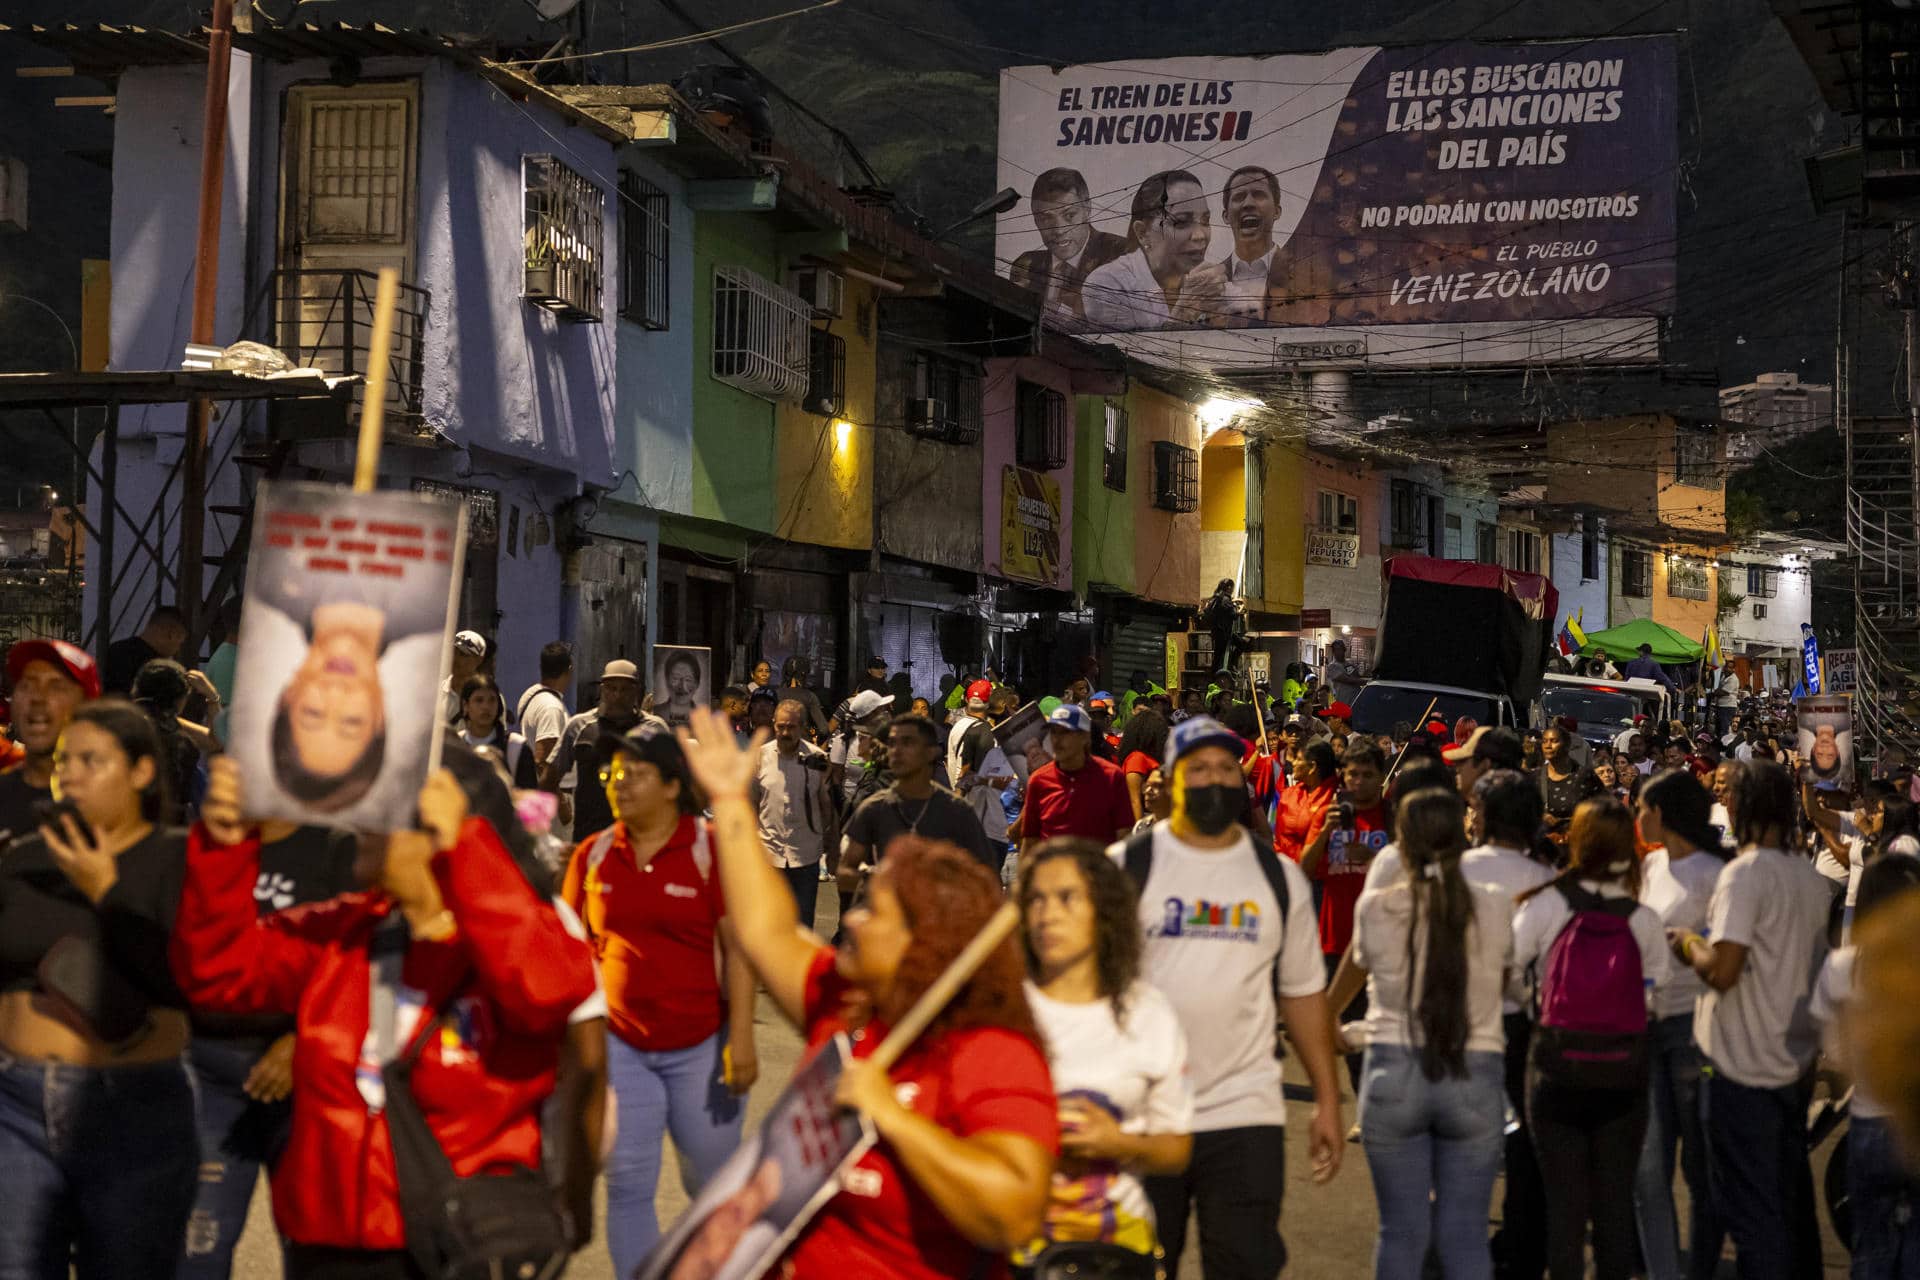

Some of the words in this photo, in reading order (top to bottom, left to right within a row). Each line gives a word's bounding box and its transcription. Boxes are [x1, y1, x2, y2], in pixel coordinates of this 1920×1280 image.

[1058, 87, 1083, 111] EL
[1091, 84, 1151, 109] TREN
[1153, 82, 1186, 107] DE
[1189, 81, 1234, 106] LAS
[1386, 66, 1467, 99] ELLOS
[1470, 59, 1624, 95] BUSCARON
[1386, 99, 1444, 132] LAS
[1447, 90, 1624, 130] SANCIONES
[1056, 111, 1220, 146] SANCIONES
[1437, 138, 1491, 170] DEL
[1497, 129, 1568, 168] PAÍS
[1360, 206, 1393, 228] NO
[1394, 199, 1481, 227] PODRÁN
[1484, 200, 1527, 223] CON
[1529, 195, 1640, 221] NOSOTROS
[1496, 246, 1519, 262] EL
[1526, 239, 1599, 260] PUEBLO
[1389, 262, 1612, 307] VENEZOLANO
[1310, 548, 1355, 558] REPUESTO
[1828, 652, 1857, 671] RECAR
